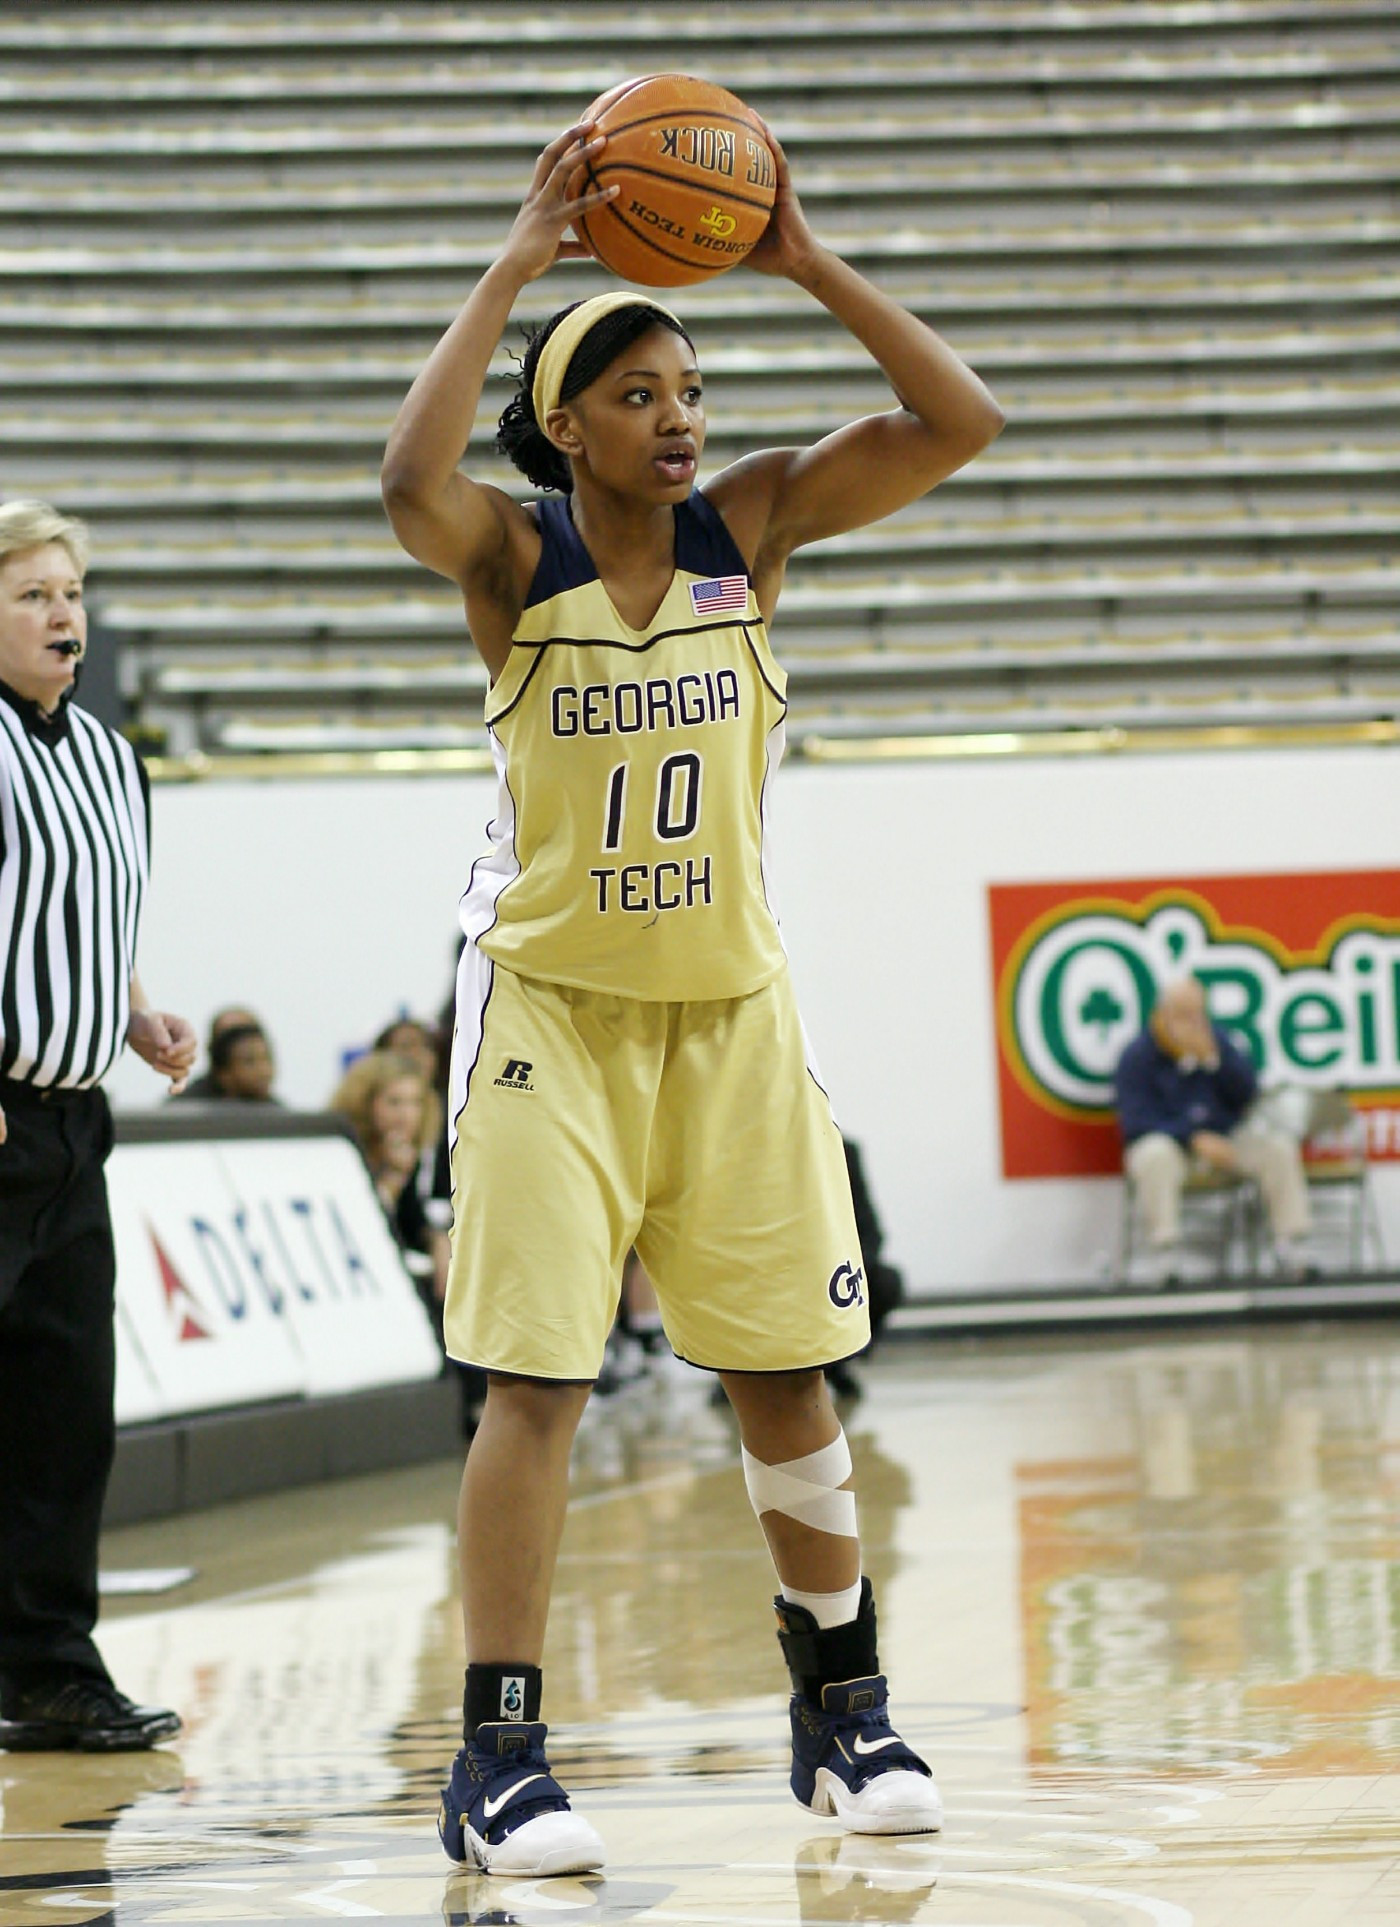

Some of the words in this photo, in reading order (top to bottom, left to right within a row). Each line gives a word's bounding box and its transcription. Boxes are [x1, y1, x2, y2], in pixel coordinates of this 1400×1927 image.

[660, 126, 736, 177] ROCK
[629, 200, 685, 239] TECH
[551, 668, 741, 738] GEORGIA
[601, 749, 703, 853] 10
[589, 855, 713, 914] TECH
[493, 1078, 535, 1091] RUSSELL
